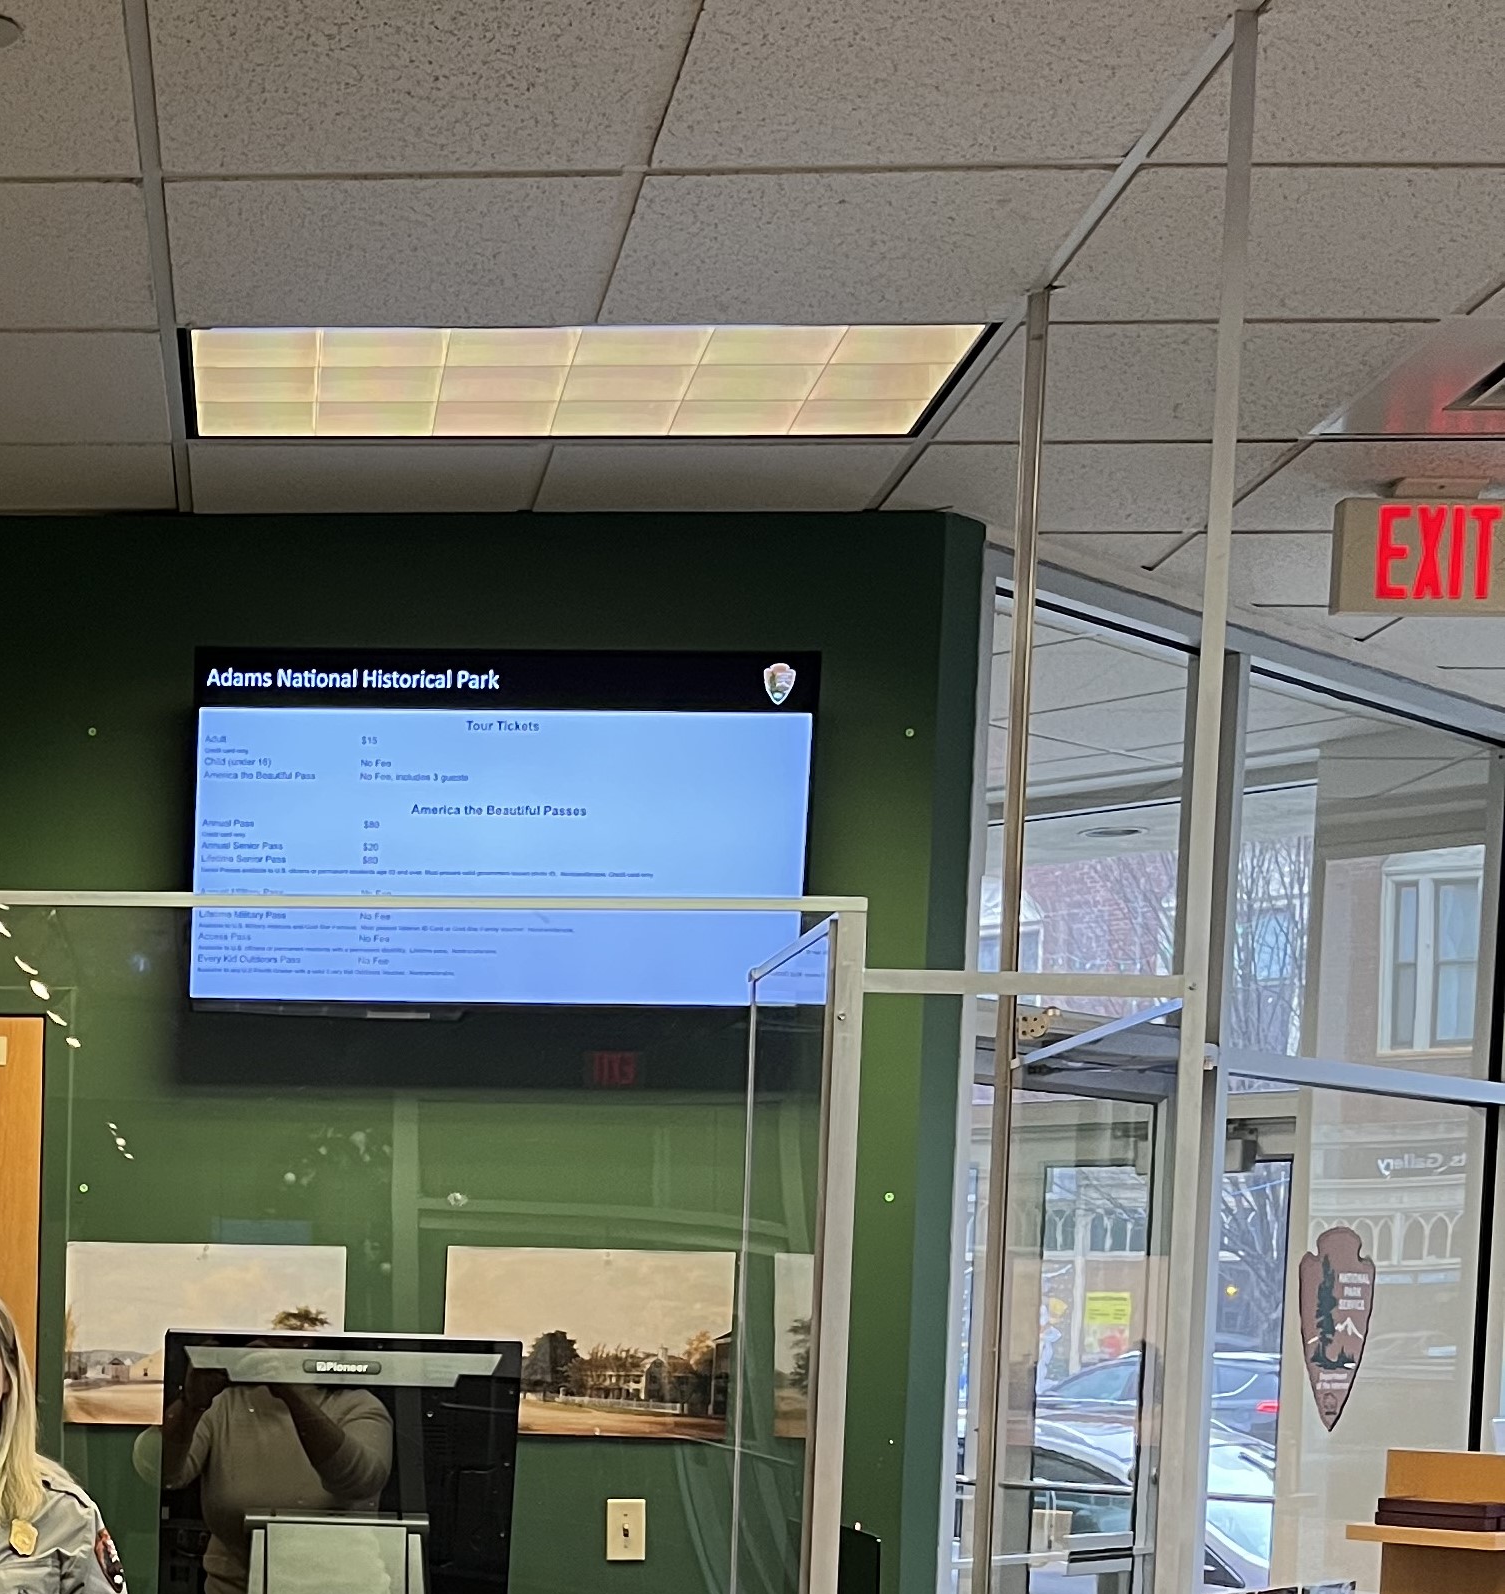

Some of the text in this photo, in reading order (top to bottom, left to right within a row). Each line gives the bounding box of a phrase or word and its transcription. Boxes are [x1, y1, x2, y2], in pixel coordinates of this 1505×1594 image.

[1375, 504, 1502, 599] EXIT
[206, 667, 500, 689] Adams National Historical Park
[465, 720, 540, 732] Tour Tickets
[204, 735, 227, 743] Adult
[361, 735, 378, 745] $15
[204, 757, 272, 768] Child (under 16)
[360, 759, 392, 767] No Fee
[203, 771, 316, 780] America the Beautiful Pass
[359, 772, 373, 781] No
[410, 804, 587, 816] America the Beautiful Passes
[202, 819, 255, 828] Annual Pass
[201, 842, 283, 851] Annual Senior Pass
[363, 843, 379, 852] $20
[200, 855, 287, 864] Lifetime Senior Pass
[198, 911, 287, 920] Lifetime Military Pass
[359, 912, 391, 920] No Fee
[198, 933, 251, 941] Access Pass
[358, 934, 390, 943] No Fee
[197, 955, 301, 964] Every Kid Outdoors Pass
[358, 957, 390, 965] No Fee
[1338, 1272, 1370, 1284] NATIONAL
[326, 1361, 369, 1373] Pioneer
